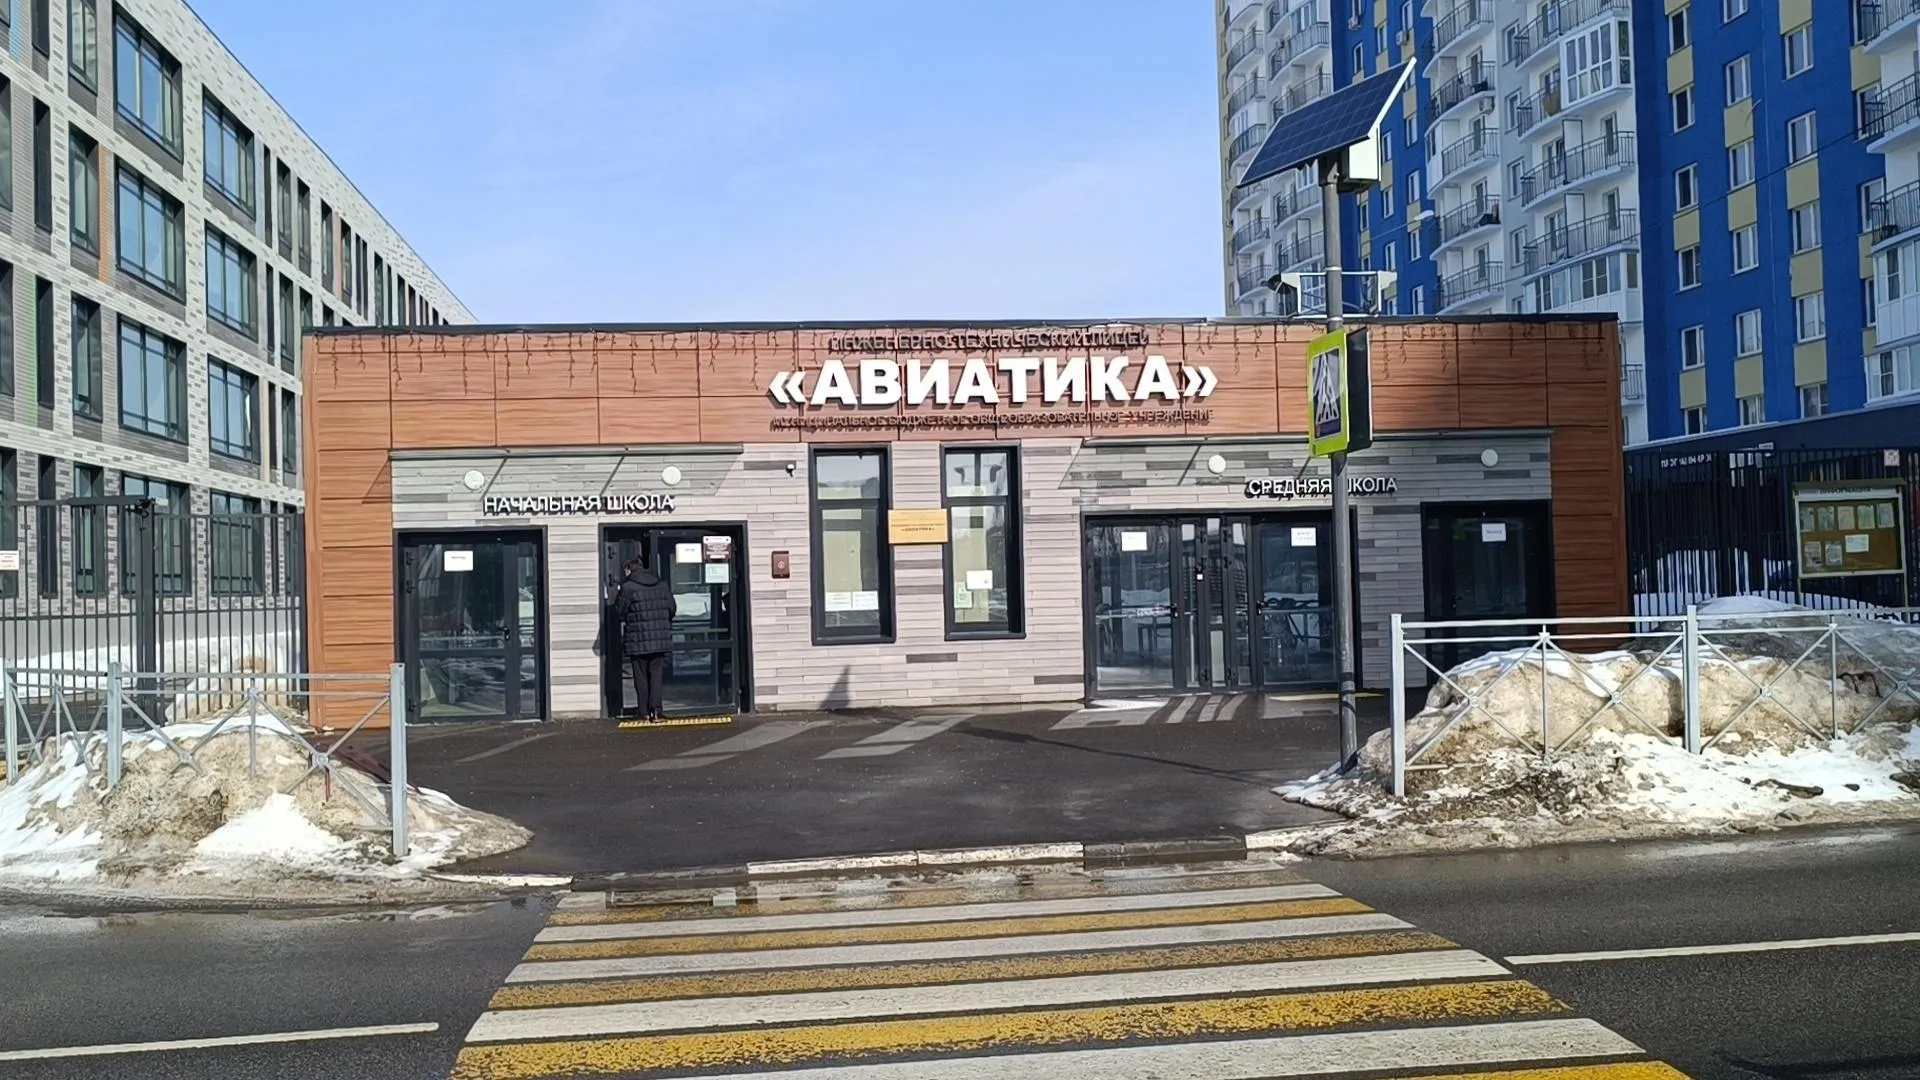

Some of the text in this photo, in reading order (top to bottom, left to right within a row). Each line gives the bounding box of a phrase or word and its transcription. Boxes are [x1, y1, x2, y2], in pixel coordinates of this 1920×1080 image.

[769, 355, 1218, 405] «АВИАТИКА»
[1248, 476, 1398, 496] СРЕДНЯЯ КОЛА
[484, 494, 675, 513] НАЧАЛЬНАЯ ШКОЛА
